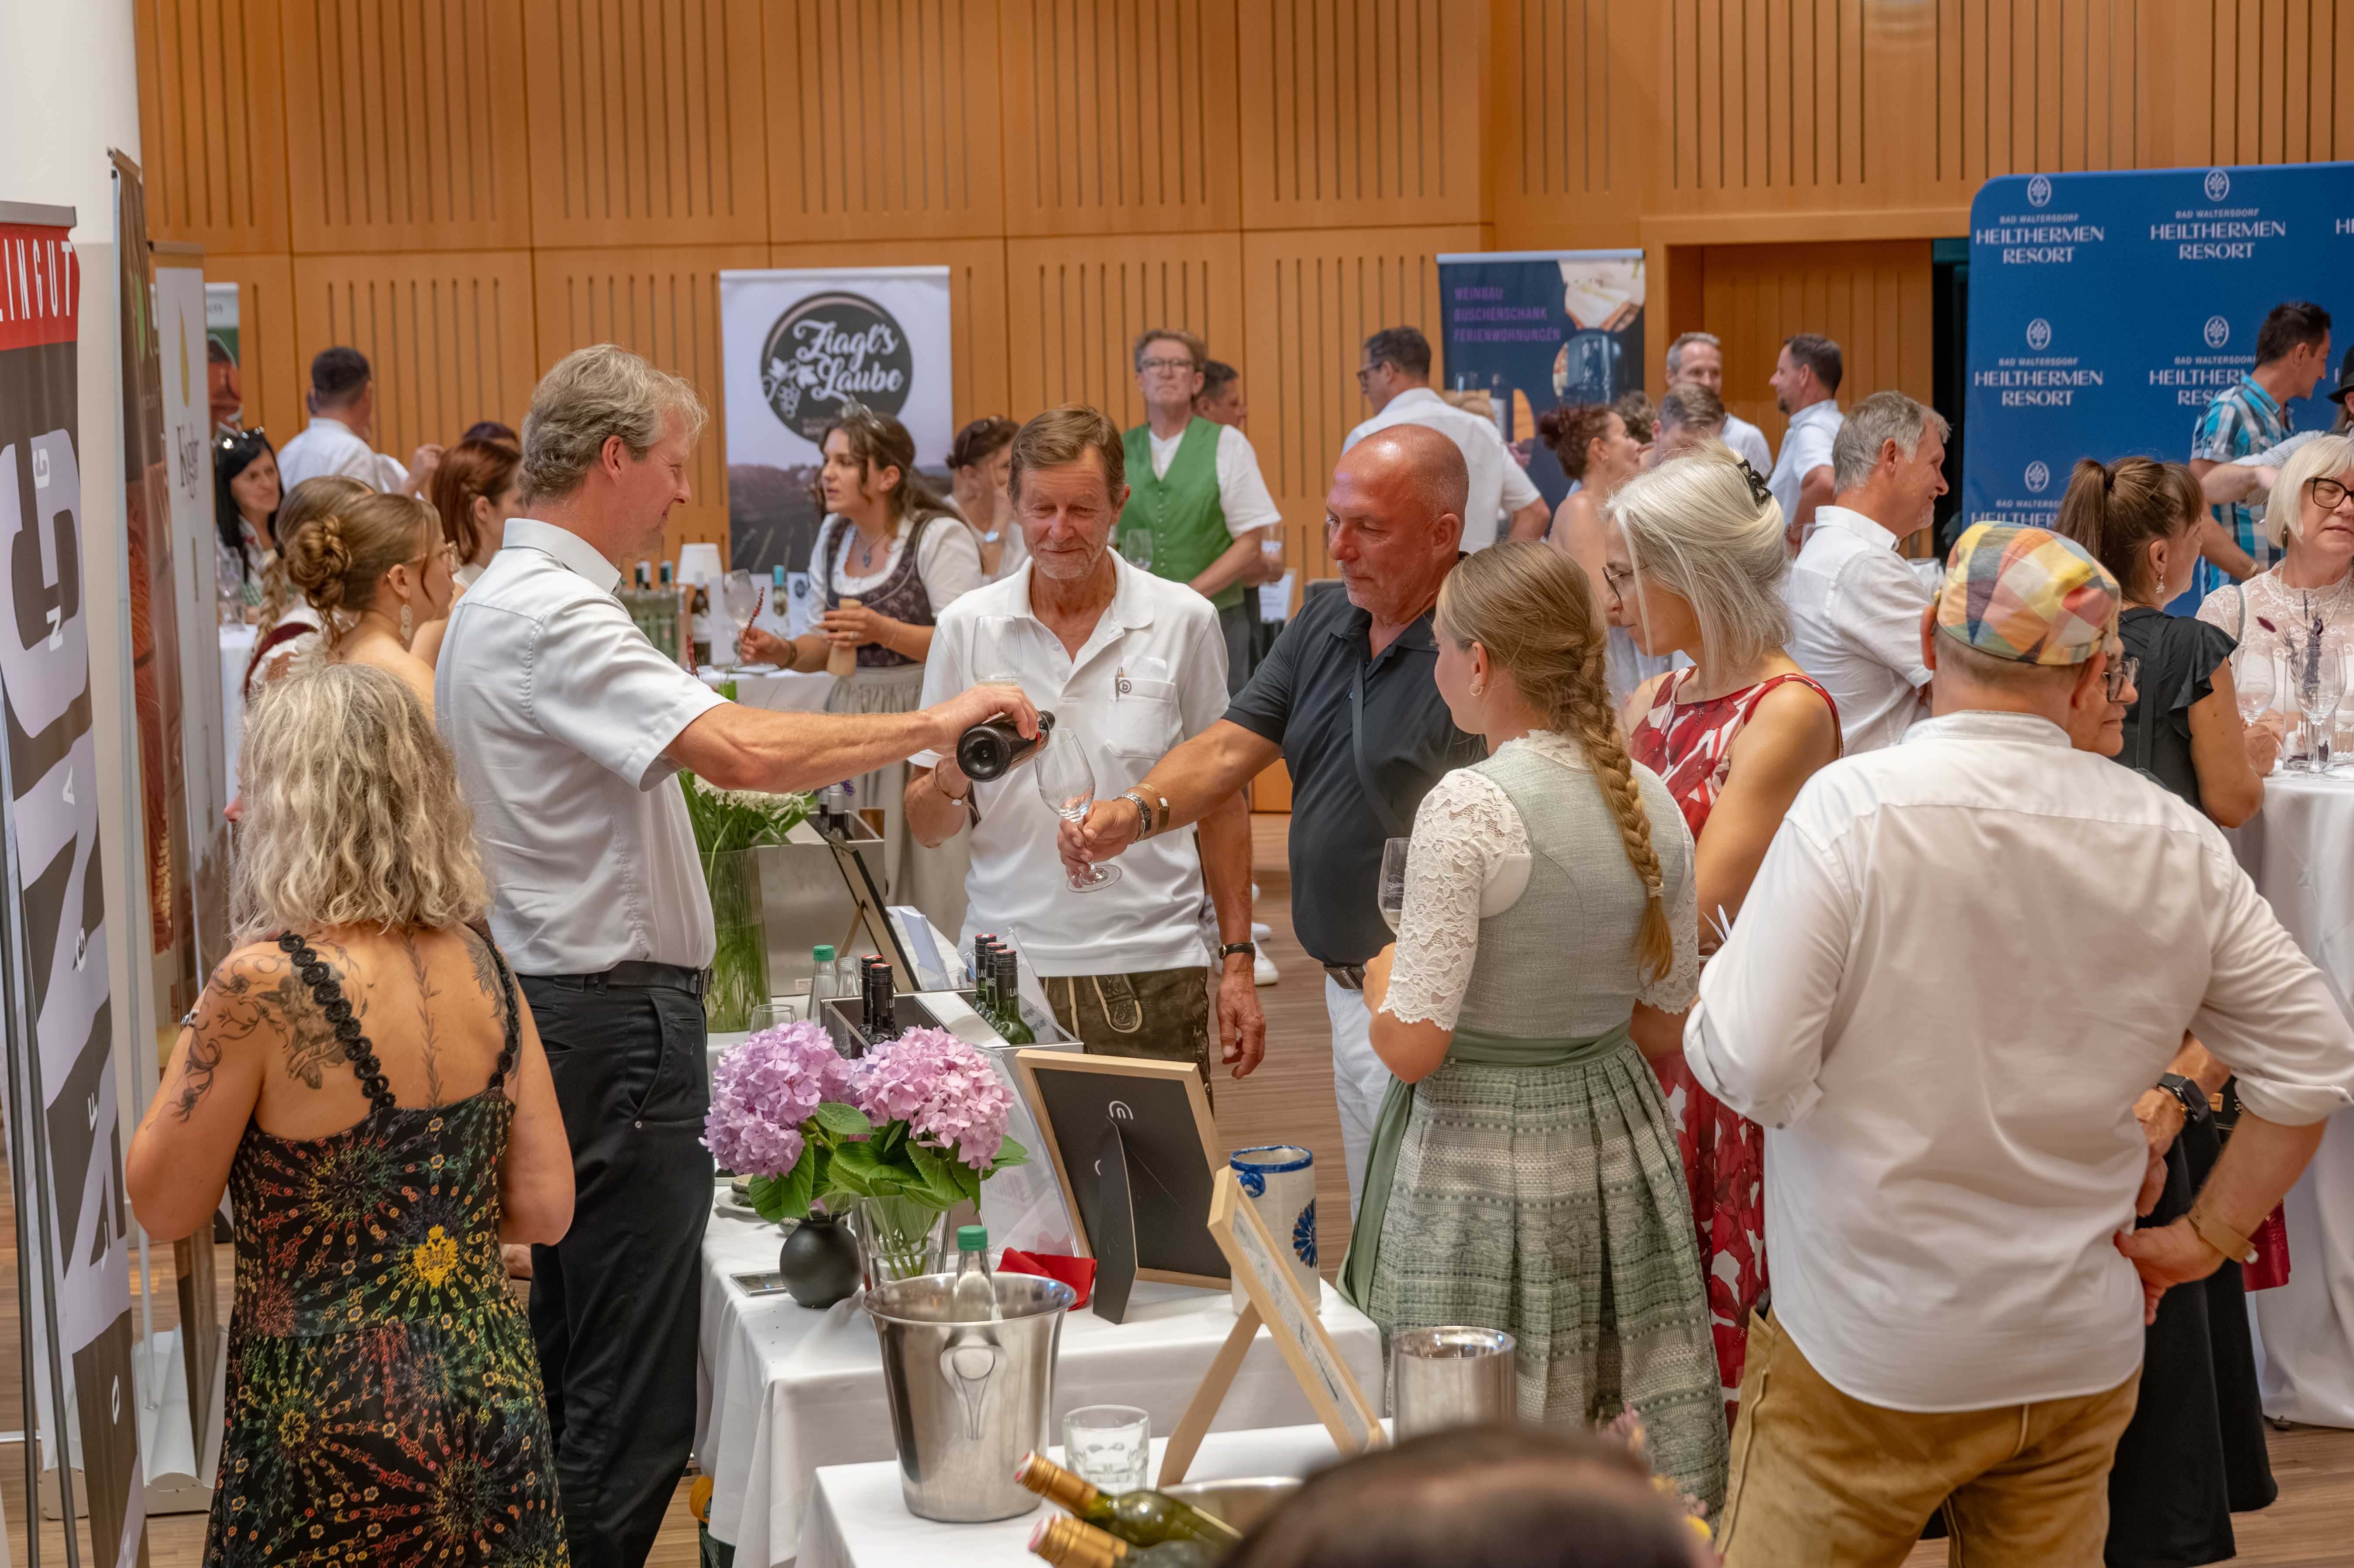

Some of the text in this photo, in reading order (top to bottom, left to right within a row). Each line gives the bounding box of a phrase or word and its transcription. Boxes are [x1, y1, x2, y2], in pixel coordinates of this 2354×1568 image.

[2000, 213, 2079, 224] BAD WALTERSDORF
[2176, 208, 2260, 219] BAD WALTERSDORF
[1976, 226, 2104, 245] HEILTHERMEN
[2150, 220, 2286, 241] HEILTHERMEN
[2003, 246, 2075, 264] RESORT
[2179, 242, 2255, 260] RESORT
[0, 238, 73, 322] INGUT
[1454, 286, 1503, 300] WEINBAU
[1454, 307, 1547, 321] BUSCHENSCHANK
[1453, 328, 1560, 342] FERIENWOHNUNGEN
[1999, 357, 2079, 367] BAD WALTERSDORF
[2174, 355, 2256, 365] BAD WALTERSDOR
[1974, 370, 2103, 386] HEILTHERMEN
[2001, 390, 2074, 406] RESORT
